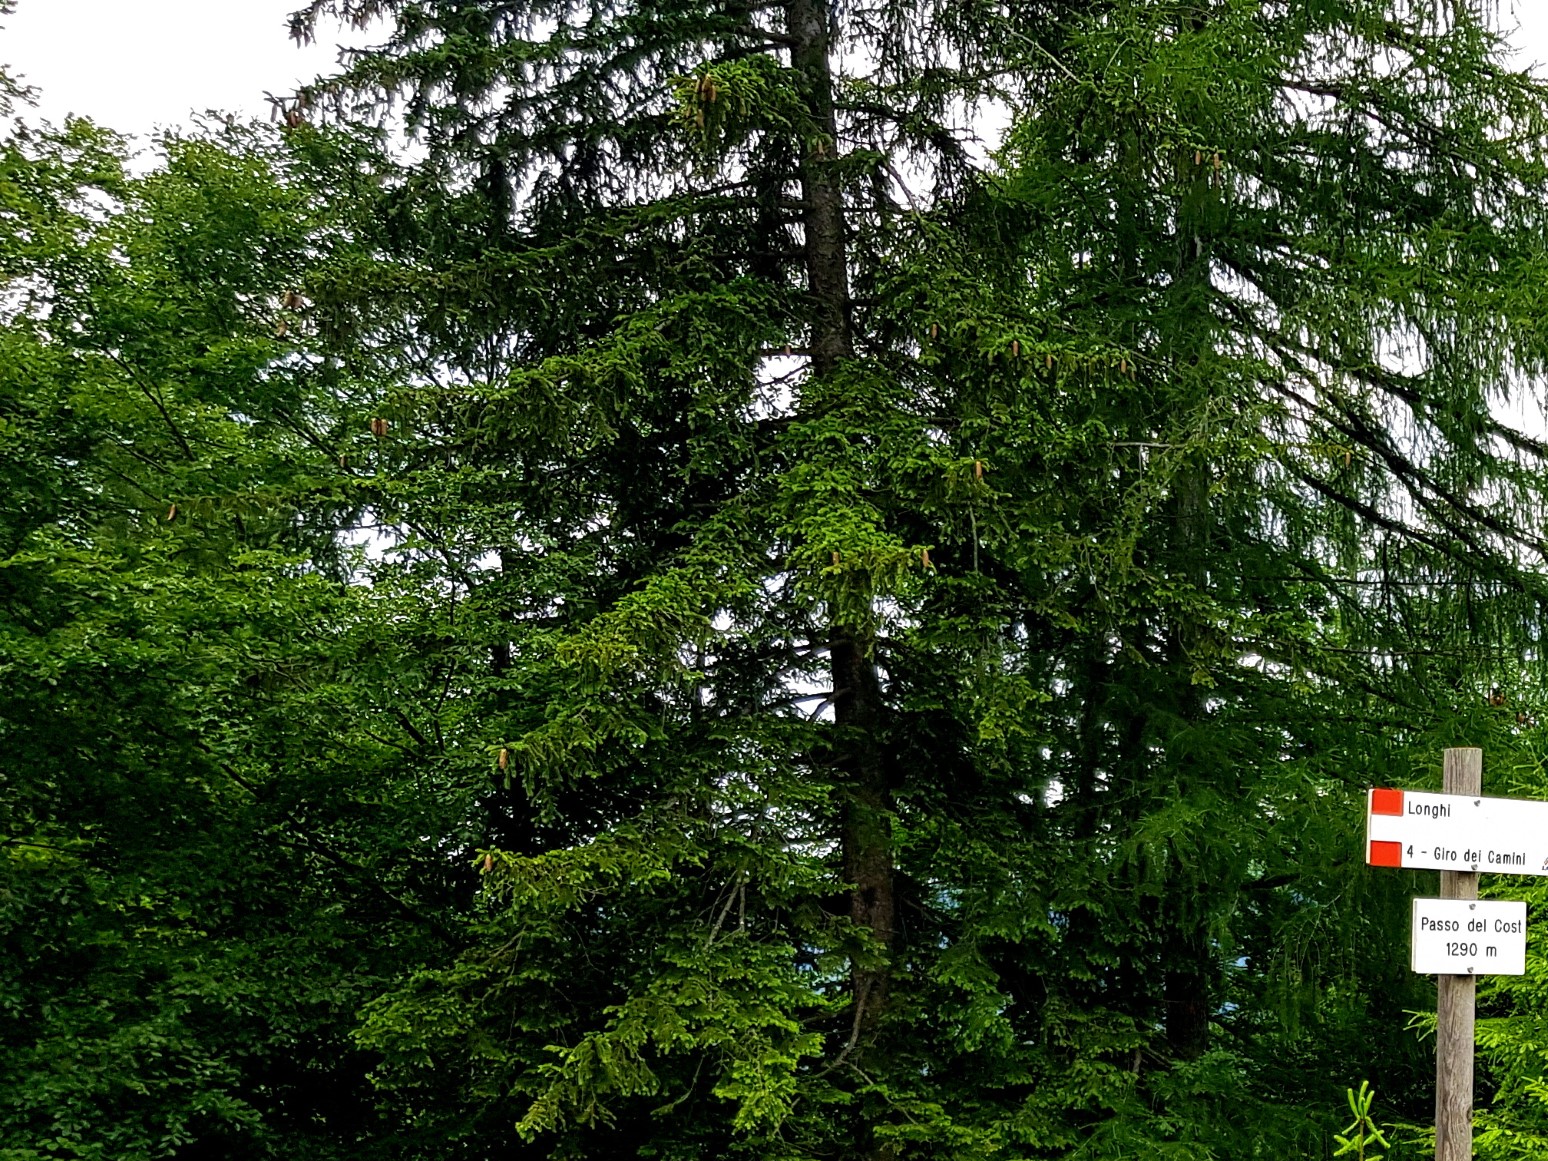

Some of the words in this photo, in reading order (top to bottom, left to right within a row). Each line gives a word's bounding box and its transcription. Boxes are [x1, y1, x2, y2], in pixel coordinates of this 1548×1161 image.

[1408, 801, 1451, 819] Longhi
[1407, 845, 1414, 859] 4
[1434, 846, 1457, 861] Giro
[1464, 847, 1482, 862] dei
[1488, 850, 1526, 865] Camini
[1421, 917, 1459, 932] Passo
[1468, 918, 1487, 933] del
[1494, 919, 1522, 934] Cost
[1446, 942, 1478, 957] 1290
[1486, 946, 1497, 957] m
